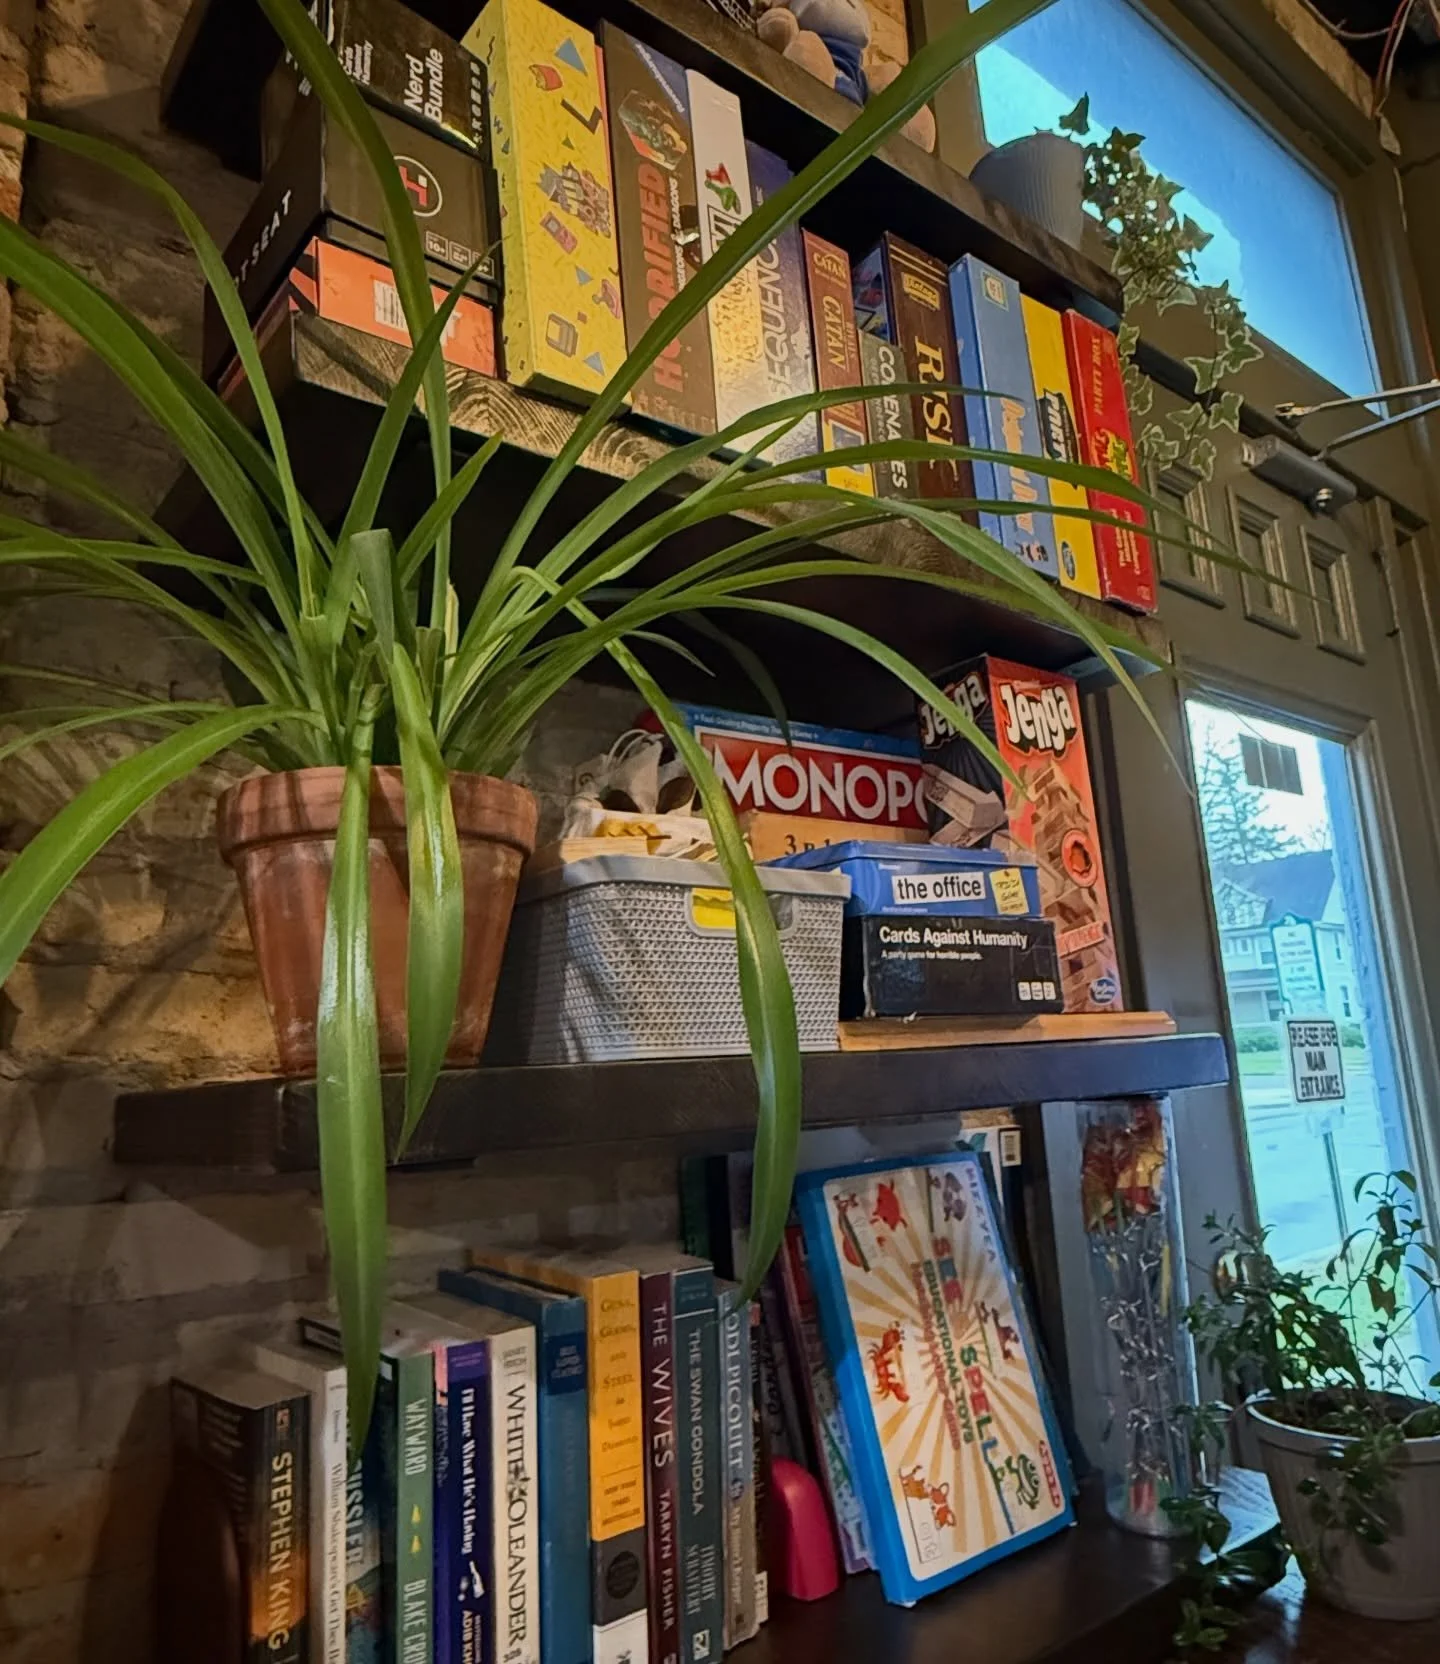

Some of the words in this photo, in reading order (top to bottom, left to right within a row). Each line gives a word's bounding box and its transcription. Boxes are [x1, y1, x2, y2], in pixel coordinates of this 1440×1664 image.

[362, 40, 374, 85] Humanity
[404, 53, 424, 114] Nerd
[424, 48, 444, 124] Bundle
[252, 189, 291, 266] SEAT
[668, 175, 682, 230] DRAGONS
[813, 251, 847, 281] CATAN
[754, 237, 792, 397] SEQUENC
[821, 295, 846, 371] CATAN
[1090, 335, 1103, 366] BOX
[878, 345, 909, 488] COENAES
[1092, 366, 1104, 416] PARTY
[1000, 682, 1076, 752] Jenga
[897, 876, 928, 900] the
[932, 875, 982, 898] office
[879, 926, 921, 944] Cards
[923, 928, 970, 948] Against
[972, 929, 1028, 950] Humanity
[887, 951, 906, 960] party
[907, 952, 925, 960] game
[926, 951, 936, 960] for
[936, 951, 960, 960] horrible
[1300, 1074, 1341, 1098] ENTRANCE
[1304, 1050, 1328, 1072] MAIN
[652, 1302, 668, 1347] THE
[689, 1329, 702, 1365] THE
[922, 1259, 962, 1391] EDUCATIONAL
[956, 1394, 976, 1445] TOYS
[933, 1238, 963, 1306] SEE
[960, 1345, 999, 1466] SPELL
[651, 1358, 674, 1469] WIVES
[689, 1367, 704, 1422] SWAN
[727, 1364, 744, 1470] PICOULT
[405, 1397, 429, 1476] WAYWARD
[461, 1439, 477, 1475] What
[506, 1384, 528, 1474] WHITE
[329, 1463, 343, 1509] William
[461, 1477, 477, 1507] He's
[690, 1425, 706, 1516] GONDOLA
[269, 1451, 293, 1574] STEPHEN
[460, 1508, 477, 1555] Having
[658, 1488, 673, 1561] TARRYN
[328, 1510, 344, 1590] Shakespeare's
[507, 1498, 529, 1649] OLEANDER
[701, 1544, 716, 1602] TIMOTHY
[267, 1577, 290, 1651] KING
[403, 1578, 428, 1631] BLAKE
[461, 1609, 474, 1643] ADIB
[662, 1565, 676, 1630] FISHER
